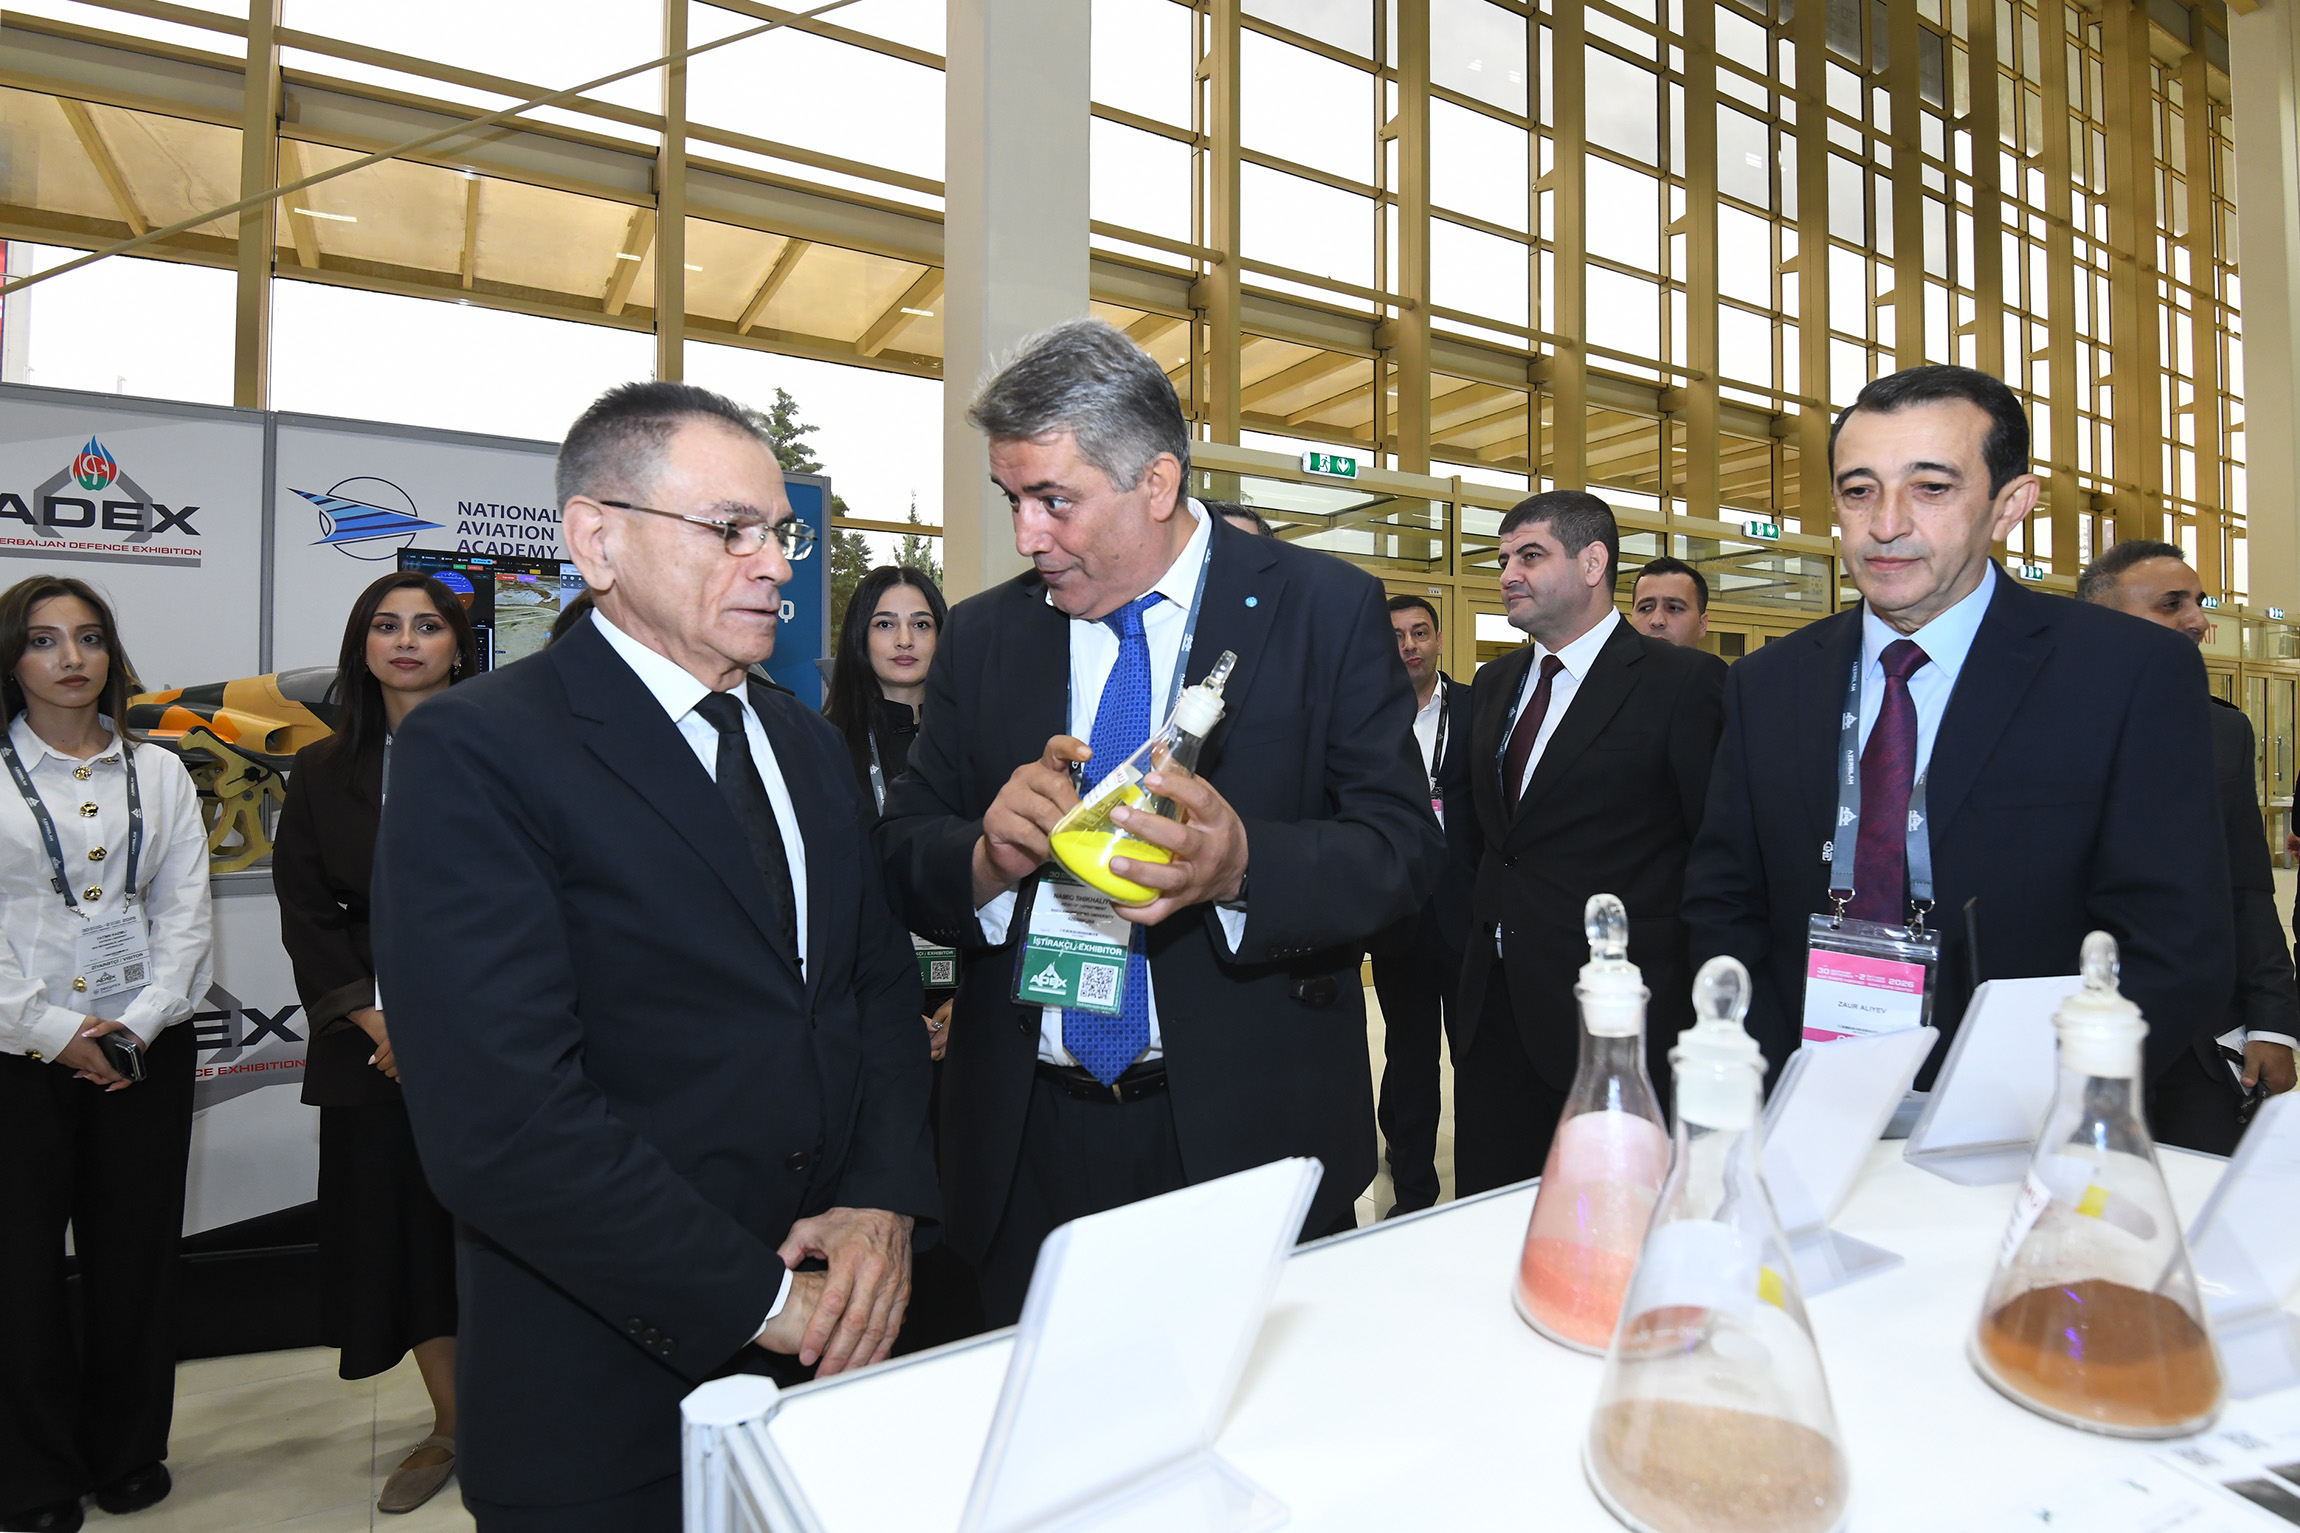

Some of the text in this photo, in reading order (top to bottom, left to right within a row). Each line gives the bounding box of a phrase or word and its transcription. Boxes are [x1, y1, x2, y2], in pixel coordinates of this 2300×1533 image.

[0, 493, 201, 536] ADEX
[458, 501, 562, 523] NATIONAL
[457, 520, 554, 541] AVIATION
[69, 541, 129, 552] DEFENCE
[132, 545, 202, 556] EXHIBITION
[457, 539, 558, 559] ACADEMY
[1053, 892, 1074, 901] NAMIQ
[1078, 943, 1123, 956] EXHIBITOR
[1030, 975, 1068, 988] ADEX
[1817, 967, 1830, 975] 30
[1888, 978, 1915, 988] 2026
[1838, 1001, 1887, 1014] ZAUR ALIYEV
[218, 1059, 306, 1075] EXHIBITION
